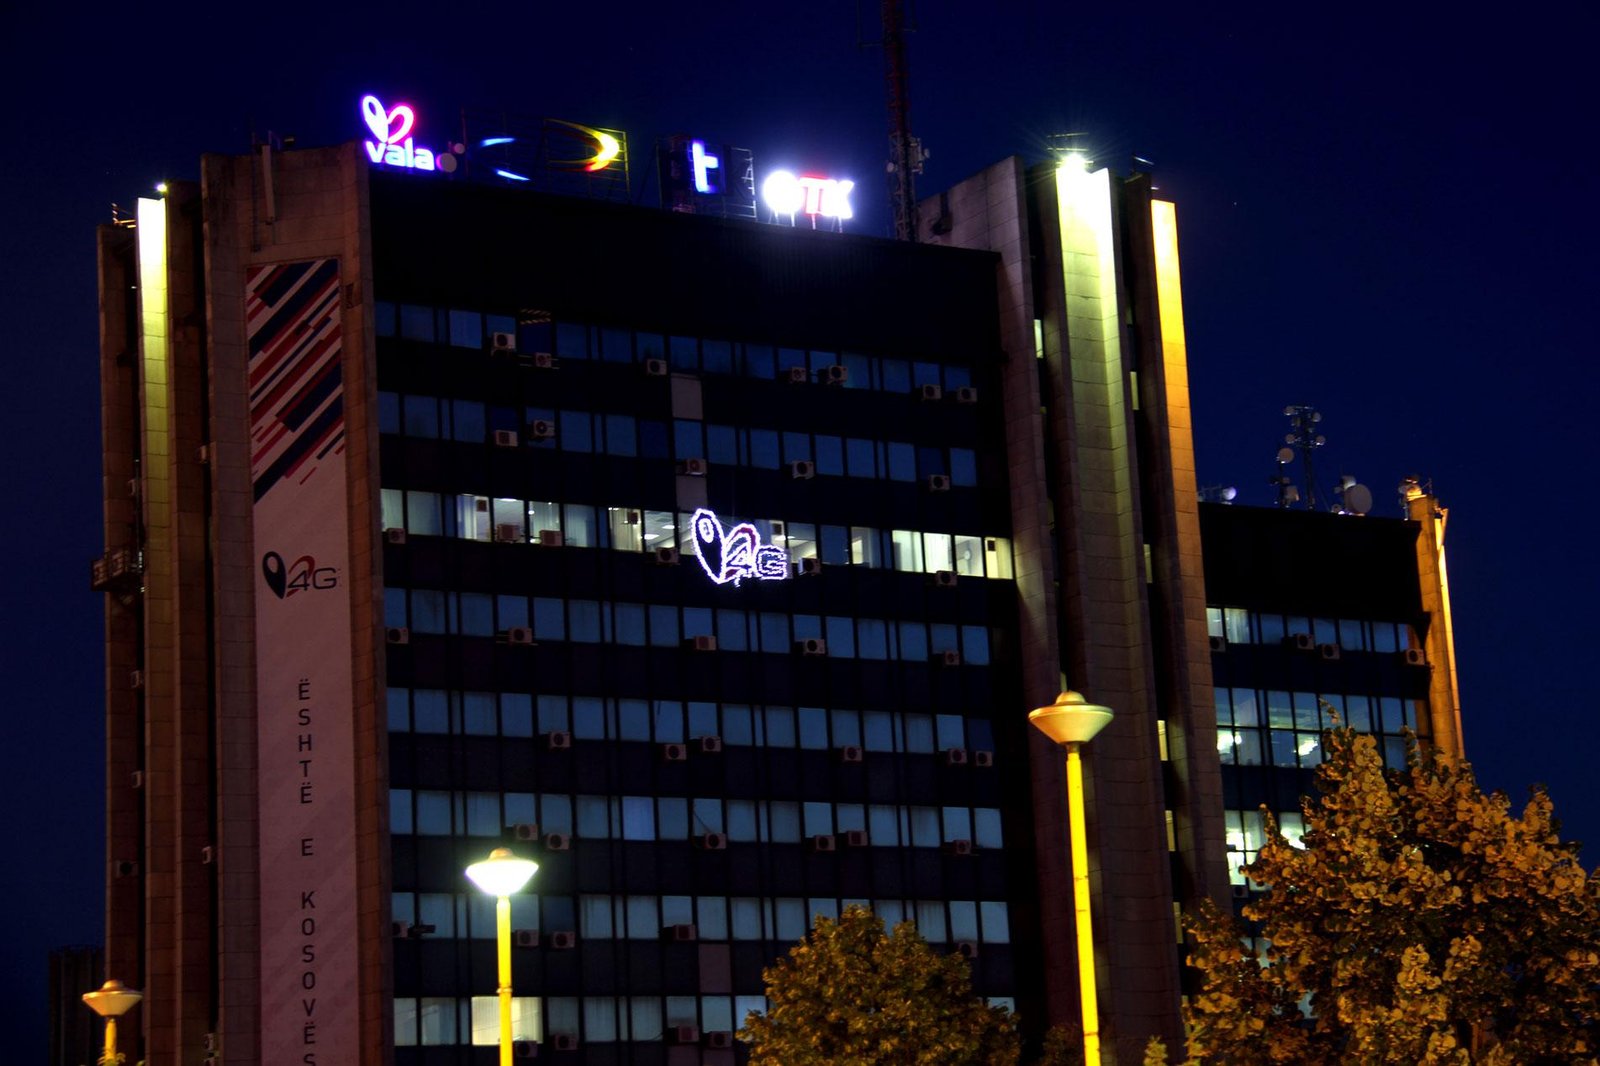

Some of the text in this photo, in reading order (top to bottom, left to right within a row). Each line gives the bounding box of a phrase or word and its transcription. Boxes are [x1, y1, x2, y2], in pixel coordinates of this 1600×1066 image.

[365, 137, 435, 171] vala
[288, 567, 337, 591] 4G
[297, 678, 313, 804] ËSHTË
[301, 838, 314, 857] E
